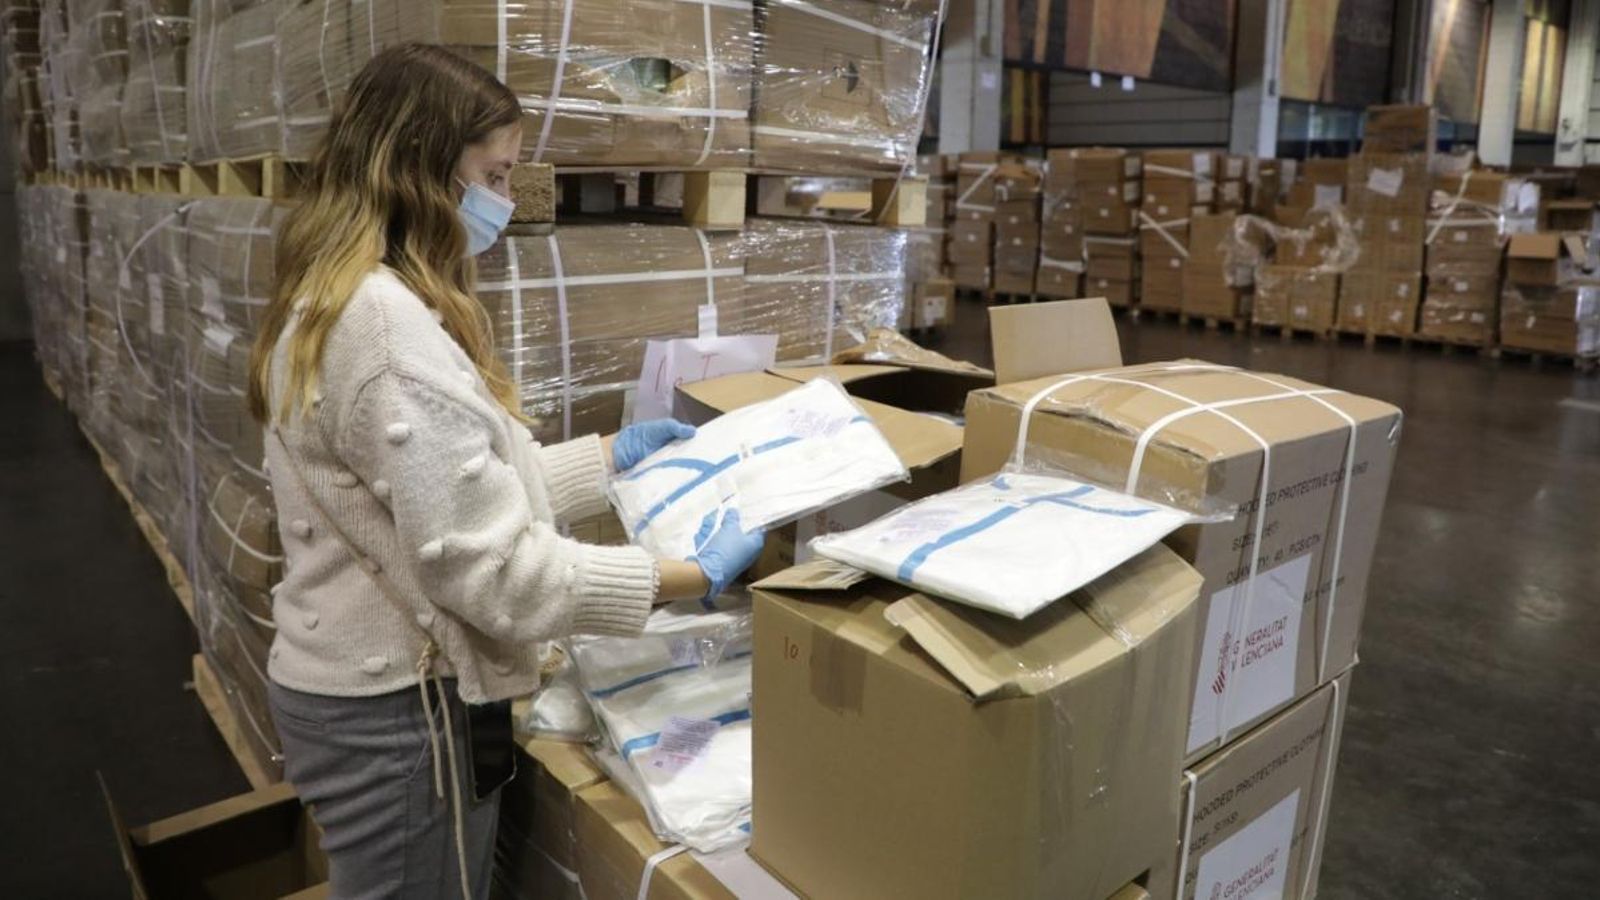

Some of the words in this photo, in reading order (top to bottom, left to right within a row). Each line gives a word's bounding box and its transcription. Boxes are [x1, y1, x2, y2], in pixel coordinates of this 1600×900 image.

[1278, 472, 1328, 502] PROTECTIVE
[1233, 615, 1288, 655] GNERALITAT
[1235, 752, 1288, 797] PROTECTIVE
